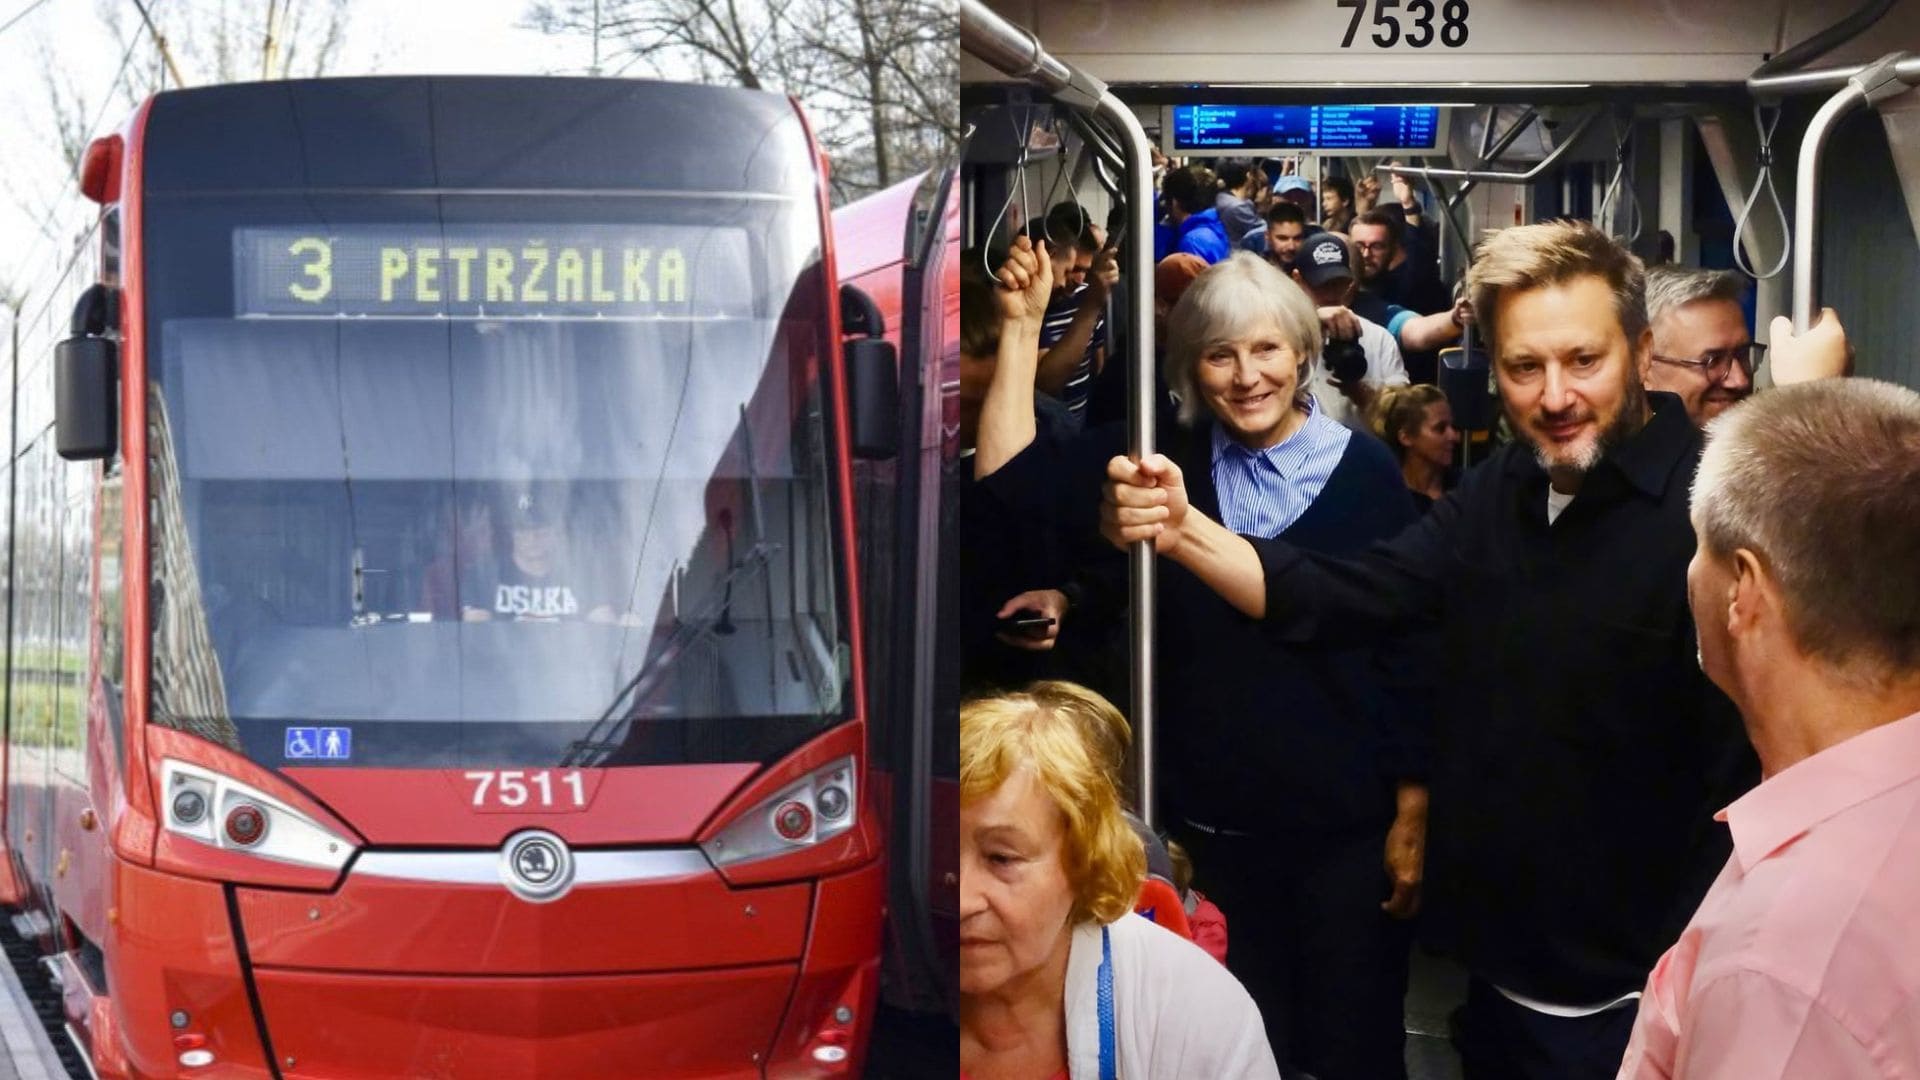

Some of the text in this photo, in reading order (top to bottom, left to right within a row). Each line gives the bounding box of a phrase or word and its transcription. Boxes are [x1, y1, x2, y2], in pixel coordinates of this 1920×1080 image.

[1337, 0, 1469, 48] 7538
[289, 238, 686, 303] 3 PETRŽALKA
[495, 584, 578, 615] OSAKA
[464, 771, 585, 806] 7511
